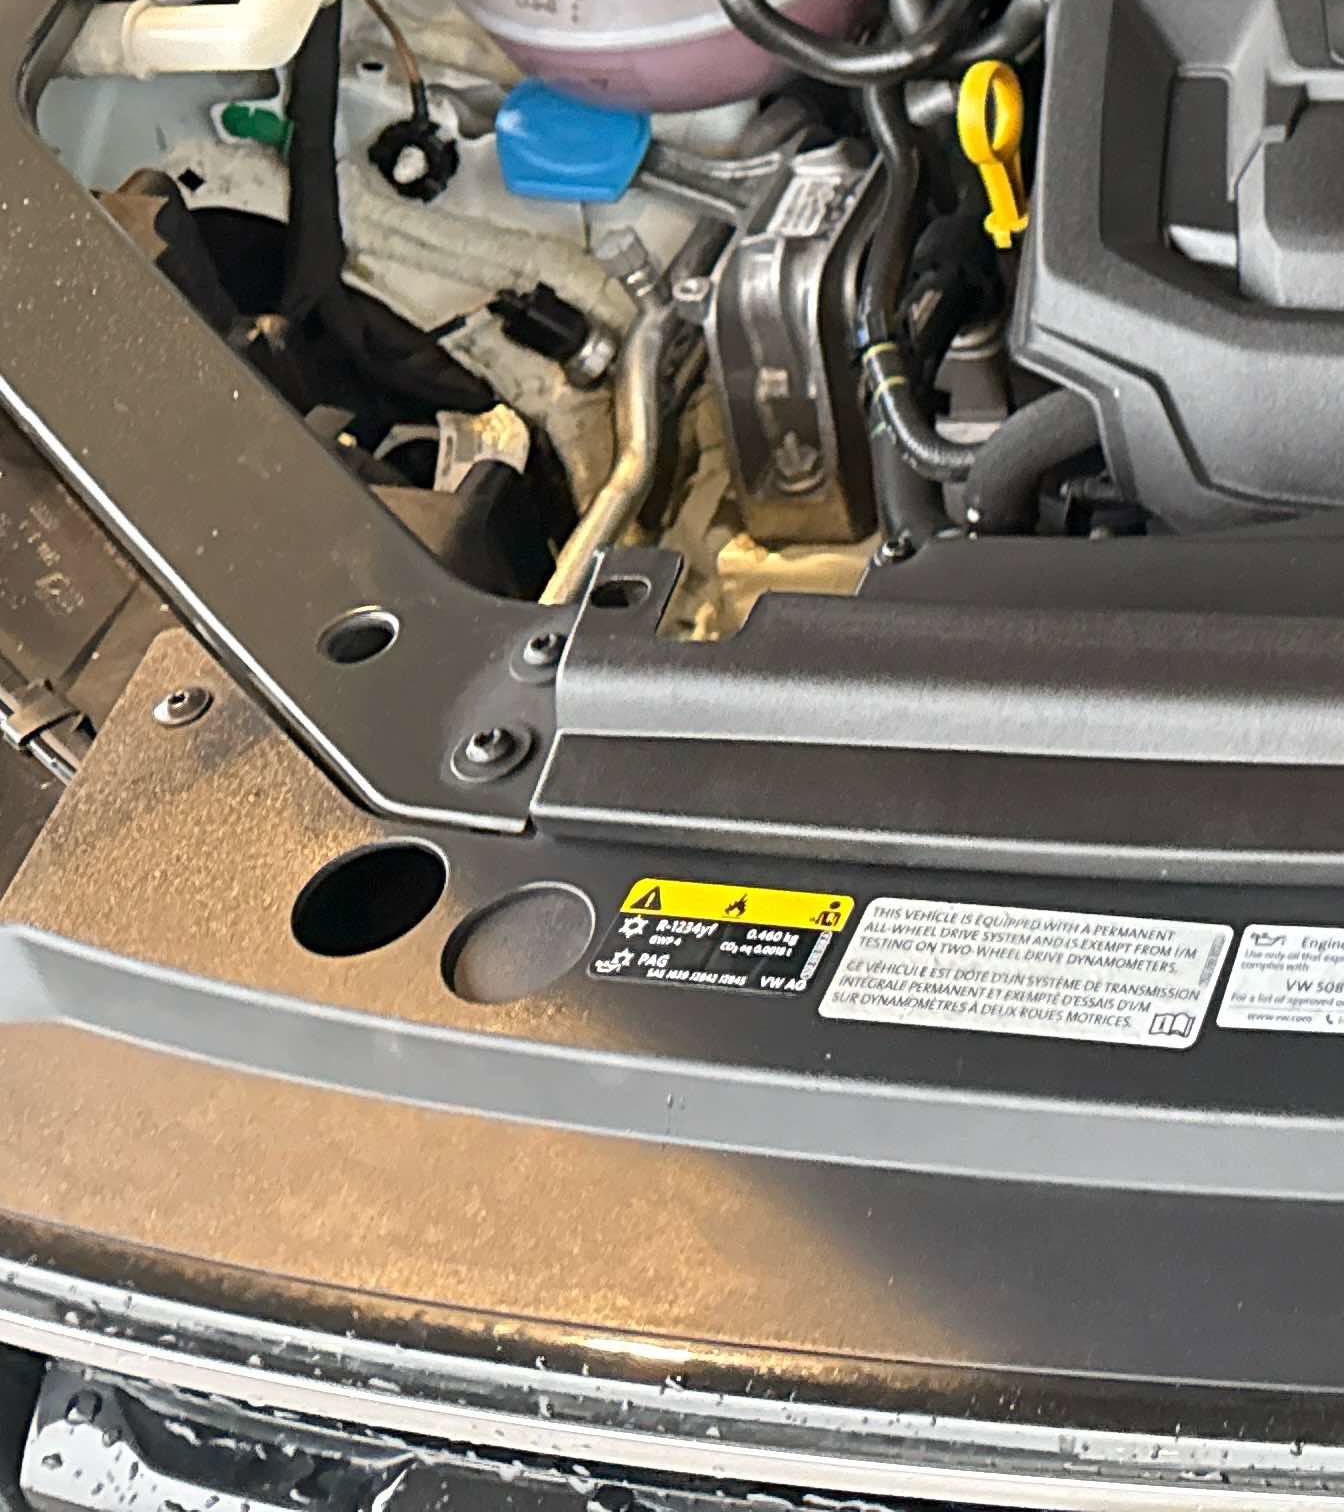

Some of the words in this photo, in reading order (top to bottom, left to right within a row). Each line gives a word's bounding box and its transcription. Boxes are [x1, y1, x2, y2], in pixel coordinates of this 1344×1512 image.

[656, 919, 719, 939] R-1234yf
[746, 929, 783, 942] 0.460
[783, 932, 799, 946] kg
[873, 906, 902, 918] THIS
[904, 908, 958, 925] VEHICLE
[960, 913, 973, 925] IS
[975, 914, 1041, 931] EQUIPPED
[1044, 919, 1080, 934] WITH
[1080, 923, 1090, 935] A
[1093, 925, 1176, 940] PERMANENT
[858, 936, 912, 951] TESTING
[915, 941, 936, 953] ON
[939, 943, 1022, 961] TWO-WHEEL
[1023, 951, 1063, 965] DRIVE
[1066, 953, 1178, 974] DYNAMOMETERS.
[864, 921, 937, 937] ALL-WHEEL
[939, 926, 980, 939] DRIVE
[982, 930, 1029, 944] SYSTEM
[1032, 935, 1064, 946] AND
[1065, 938, 1078, 947] IS
[1079, 939, 1132, 953] EXEMPT
[1133, 944, 1171, 956] FROM
[1174, 946, 1198, 960] I/M
[638, 953, 670, 967] PAG
[760, 975, 783, 989] VW
[783, 978, 807, 991] AG
[838, 974, 907, 992] INTÉGRALE
[908, 982, 985, 999] PERMANENT
[986, 987, 1002, 1000] ET
[1003, 988, 1059, 1005] EXEMPTÉ
[1061, 994, 1115, 1010] D'ESSAIS
[846, 958, 864, 972] CE
[866, 959, 928, 978] VÉHICULE
[929, 966, 951, 979] EST
[953, 967, 991, 982] DOTÉ
[991, 970, 1026, 986] D'UN
[1083, 979, 1103, 992] DE
[1104, 982, 1201, 1002] TRANSMISSION
[1285, 977, 1314, 993] VW
[832, 991, 860, 1004] SUR
[981, 1003, 1018, 1018] DEUX
[1018, 1005, 1064, 1021] ROUES
[1066, 1010, 1133, 1028] MOTRICES.
